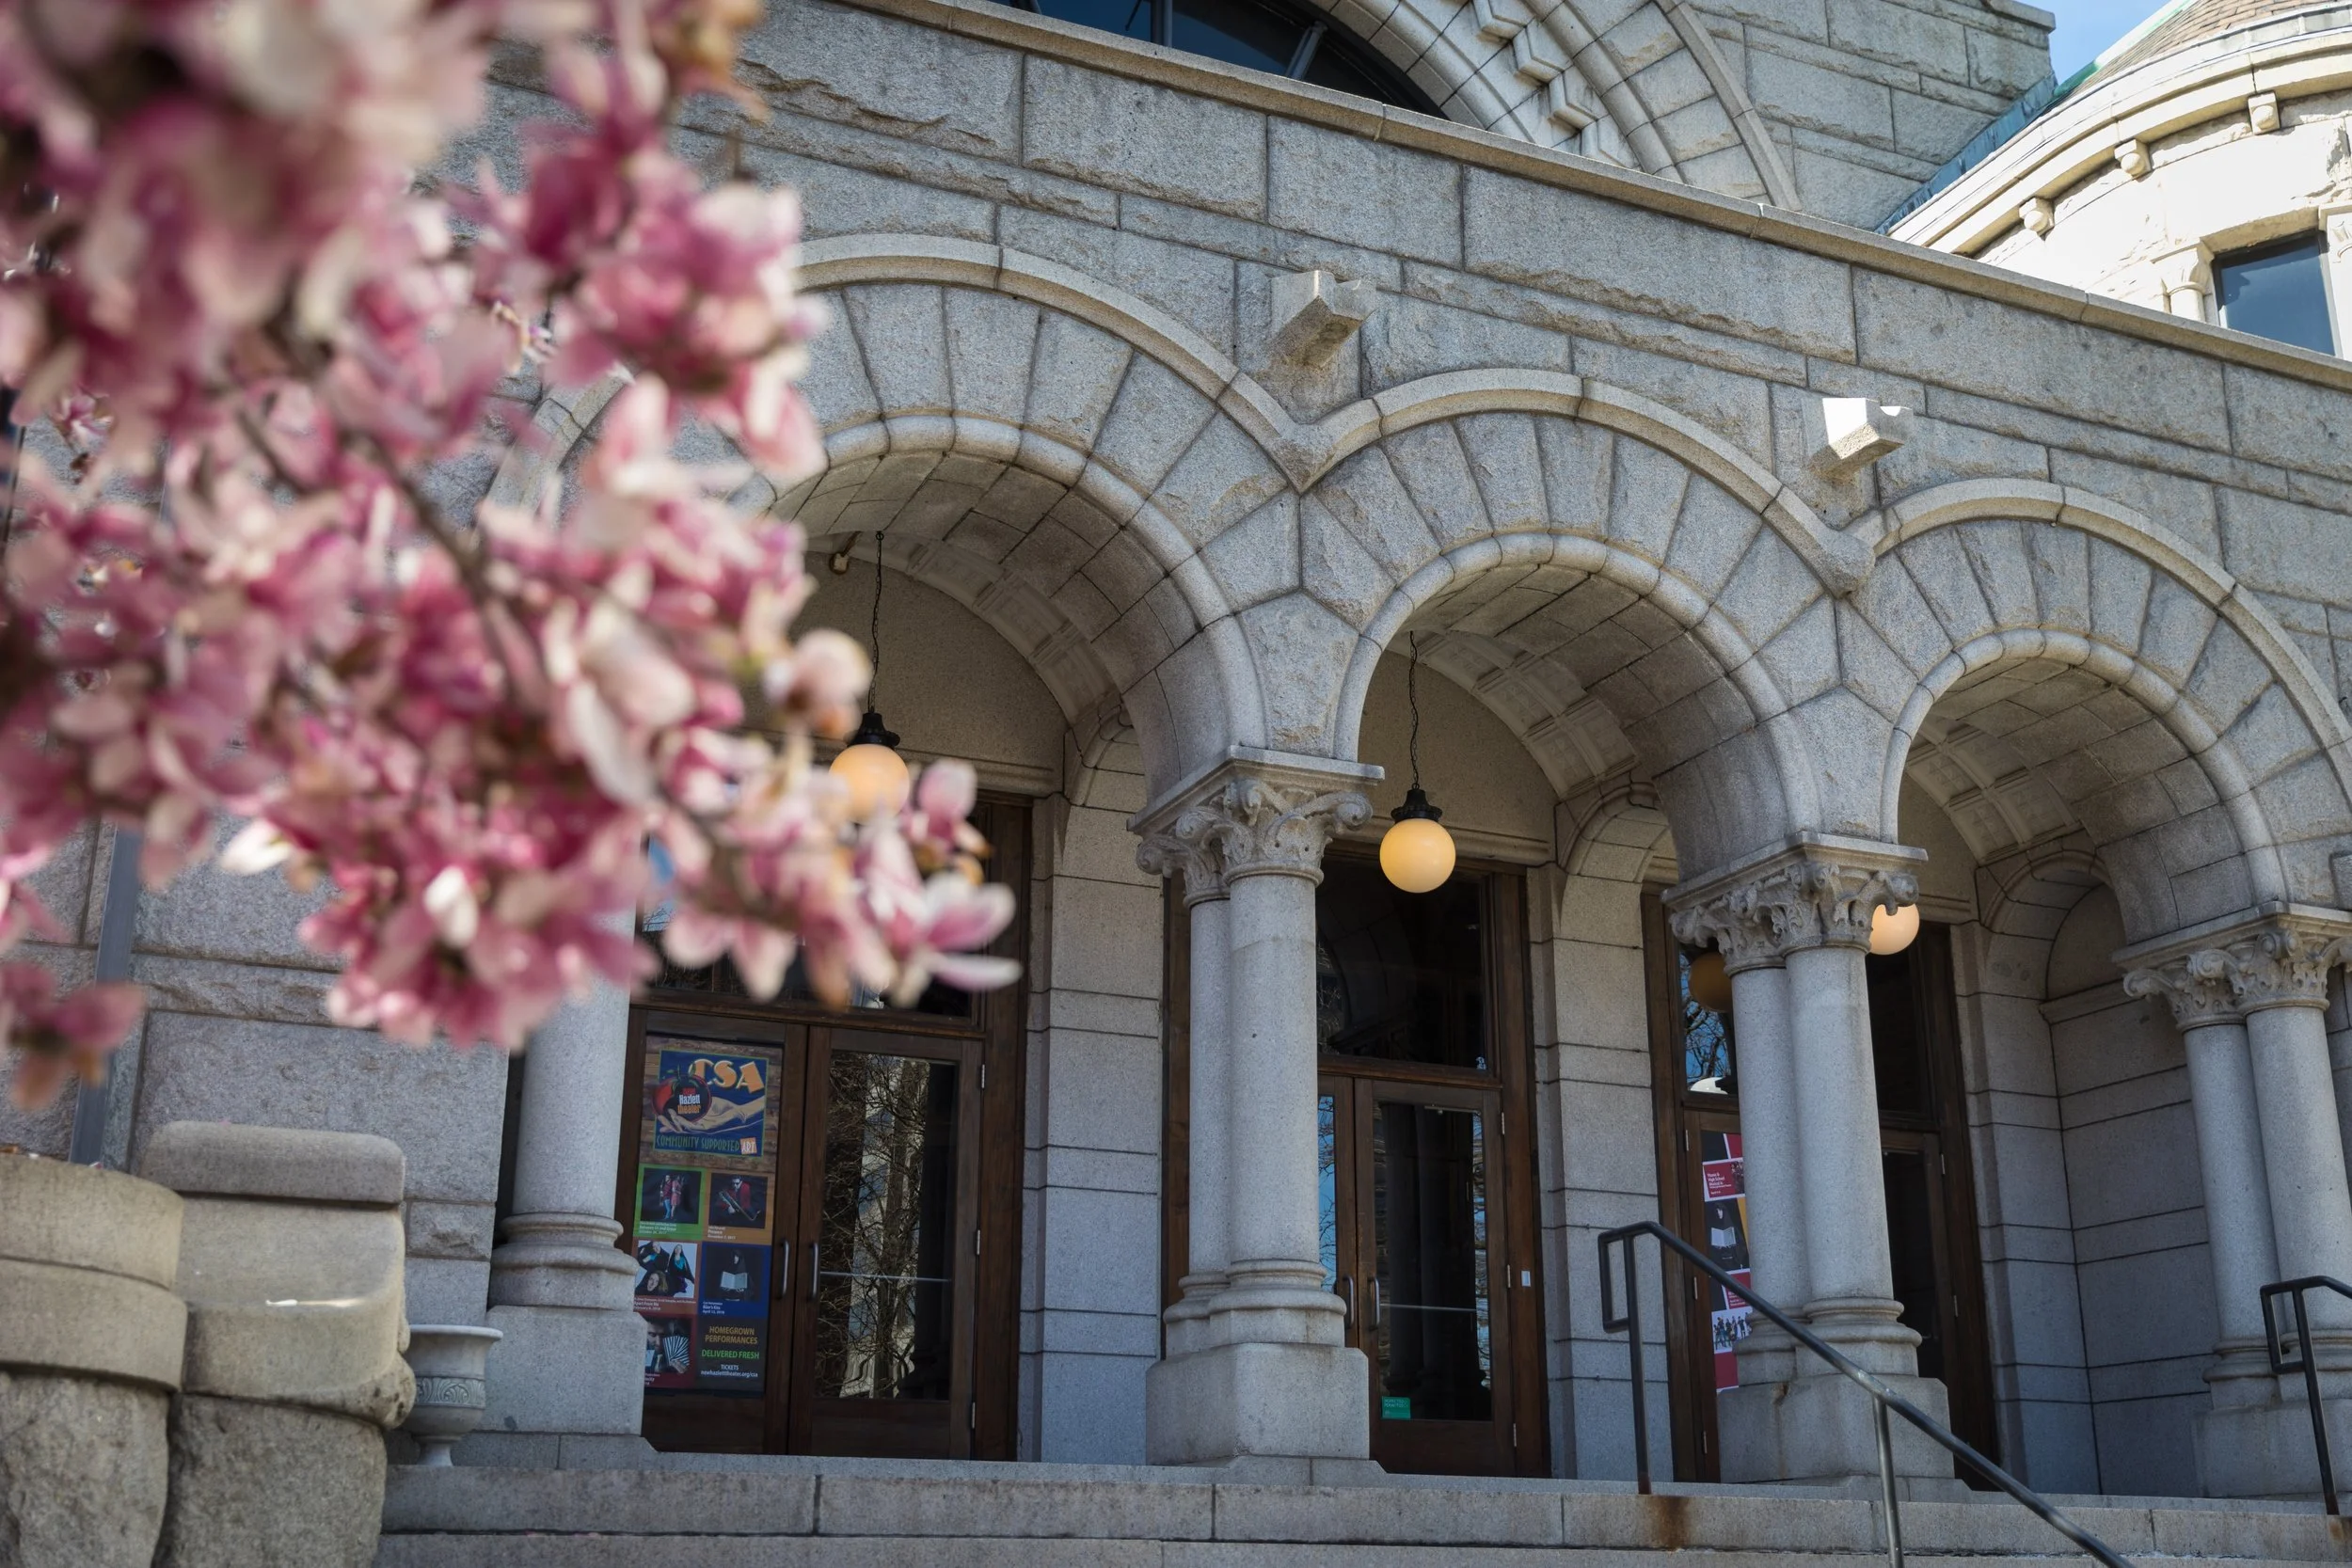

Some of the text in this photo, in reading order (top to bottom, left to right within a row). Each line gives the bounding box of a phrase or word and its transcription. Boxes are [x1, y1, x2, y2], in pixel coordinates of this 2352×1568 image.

[689, 1059, 765, 1094] CSA
[679, 1094, 701, 1105] Hazlett
[677, 1104, 702, 1115] theater
[657, 1135, 756, 1153] COMMUNITY SUPPORTED ART
[709, 1325, 755, 1336] HOMEGROWN
[705, 1335, 758, 1345] PERFORMANCES
[701, 1349, 760, 1360] DELIVERED FRESH
